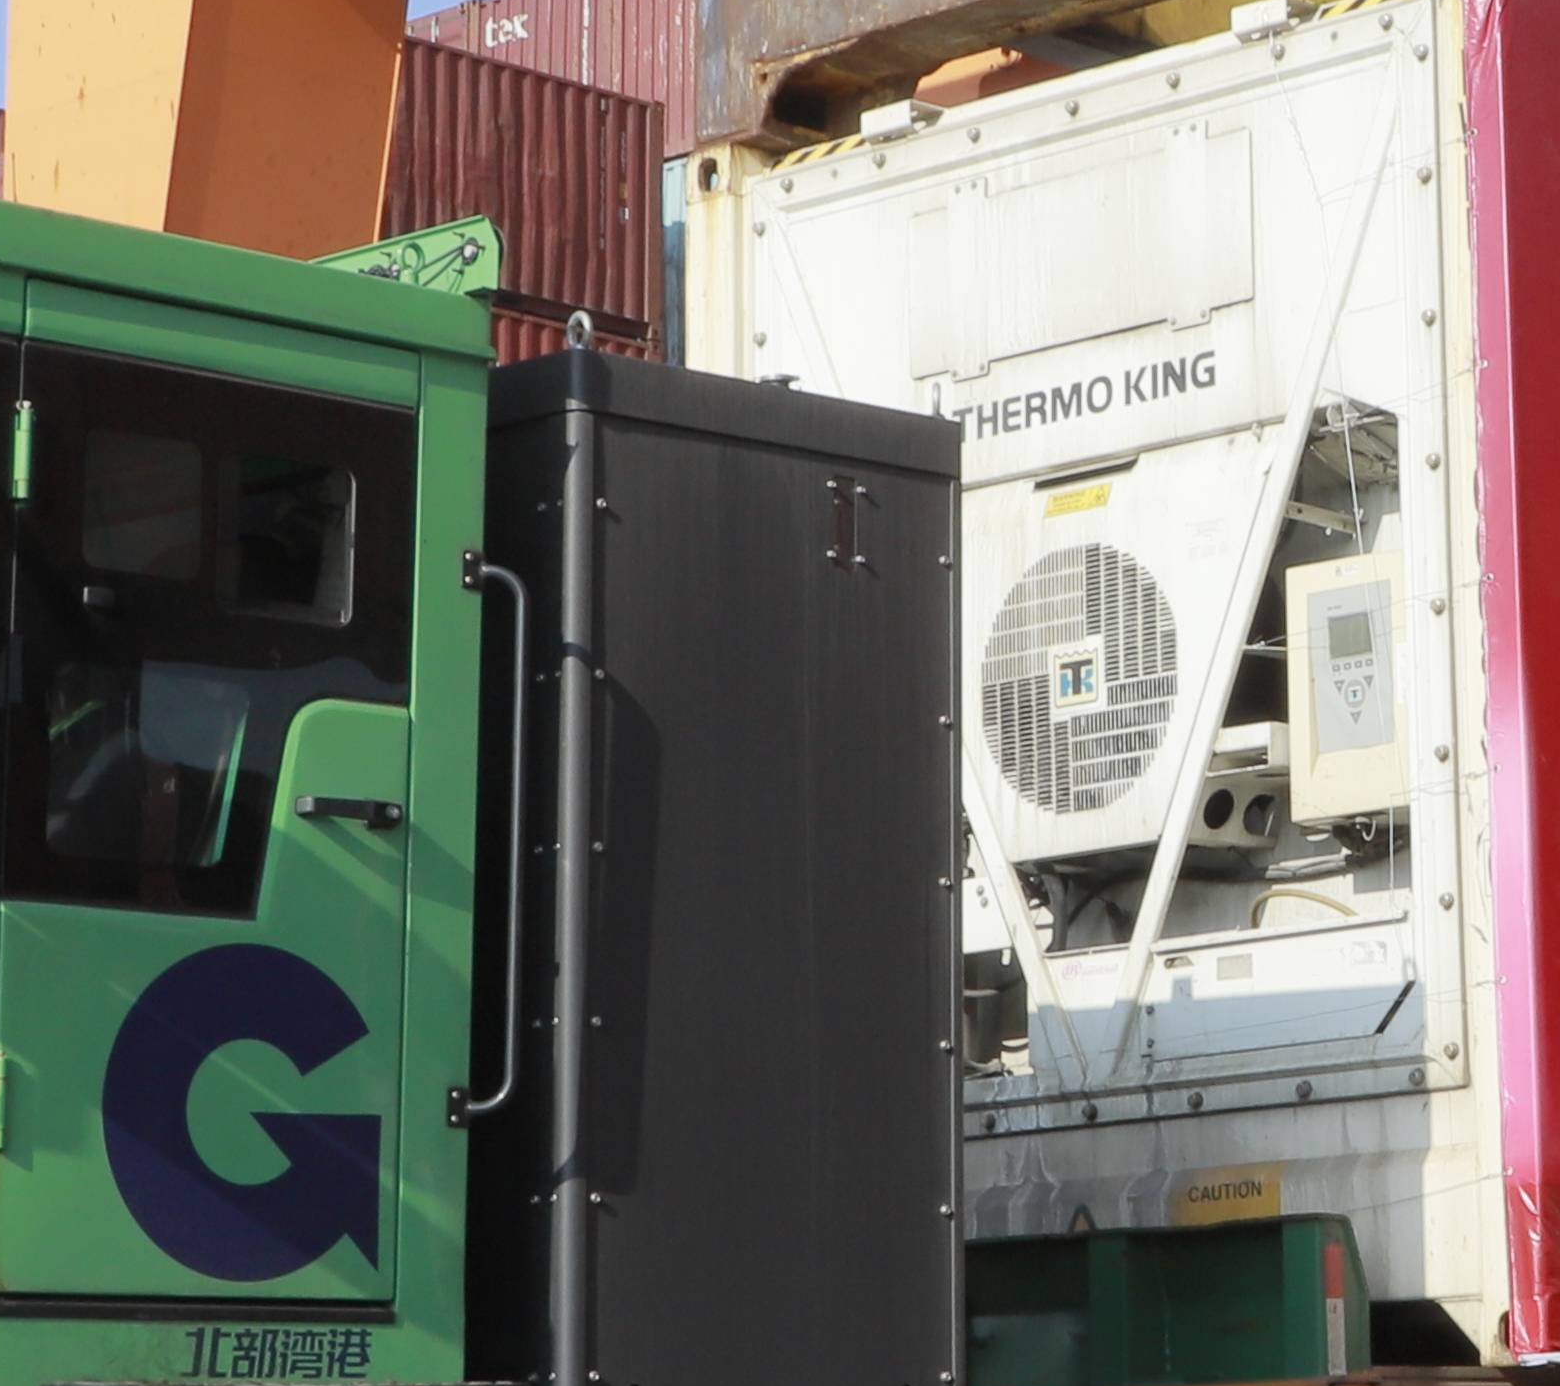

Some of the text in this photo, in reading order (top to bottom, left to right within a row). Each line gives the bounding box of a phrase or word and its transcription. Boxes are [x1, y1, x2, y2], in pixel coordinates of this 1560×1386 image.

[952, 350, 1216, 444] THERMO KING
[1187, 1179, 1263, 1204] CAUTION
[180, 1326, 374, 1380] 北部湾港
